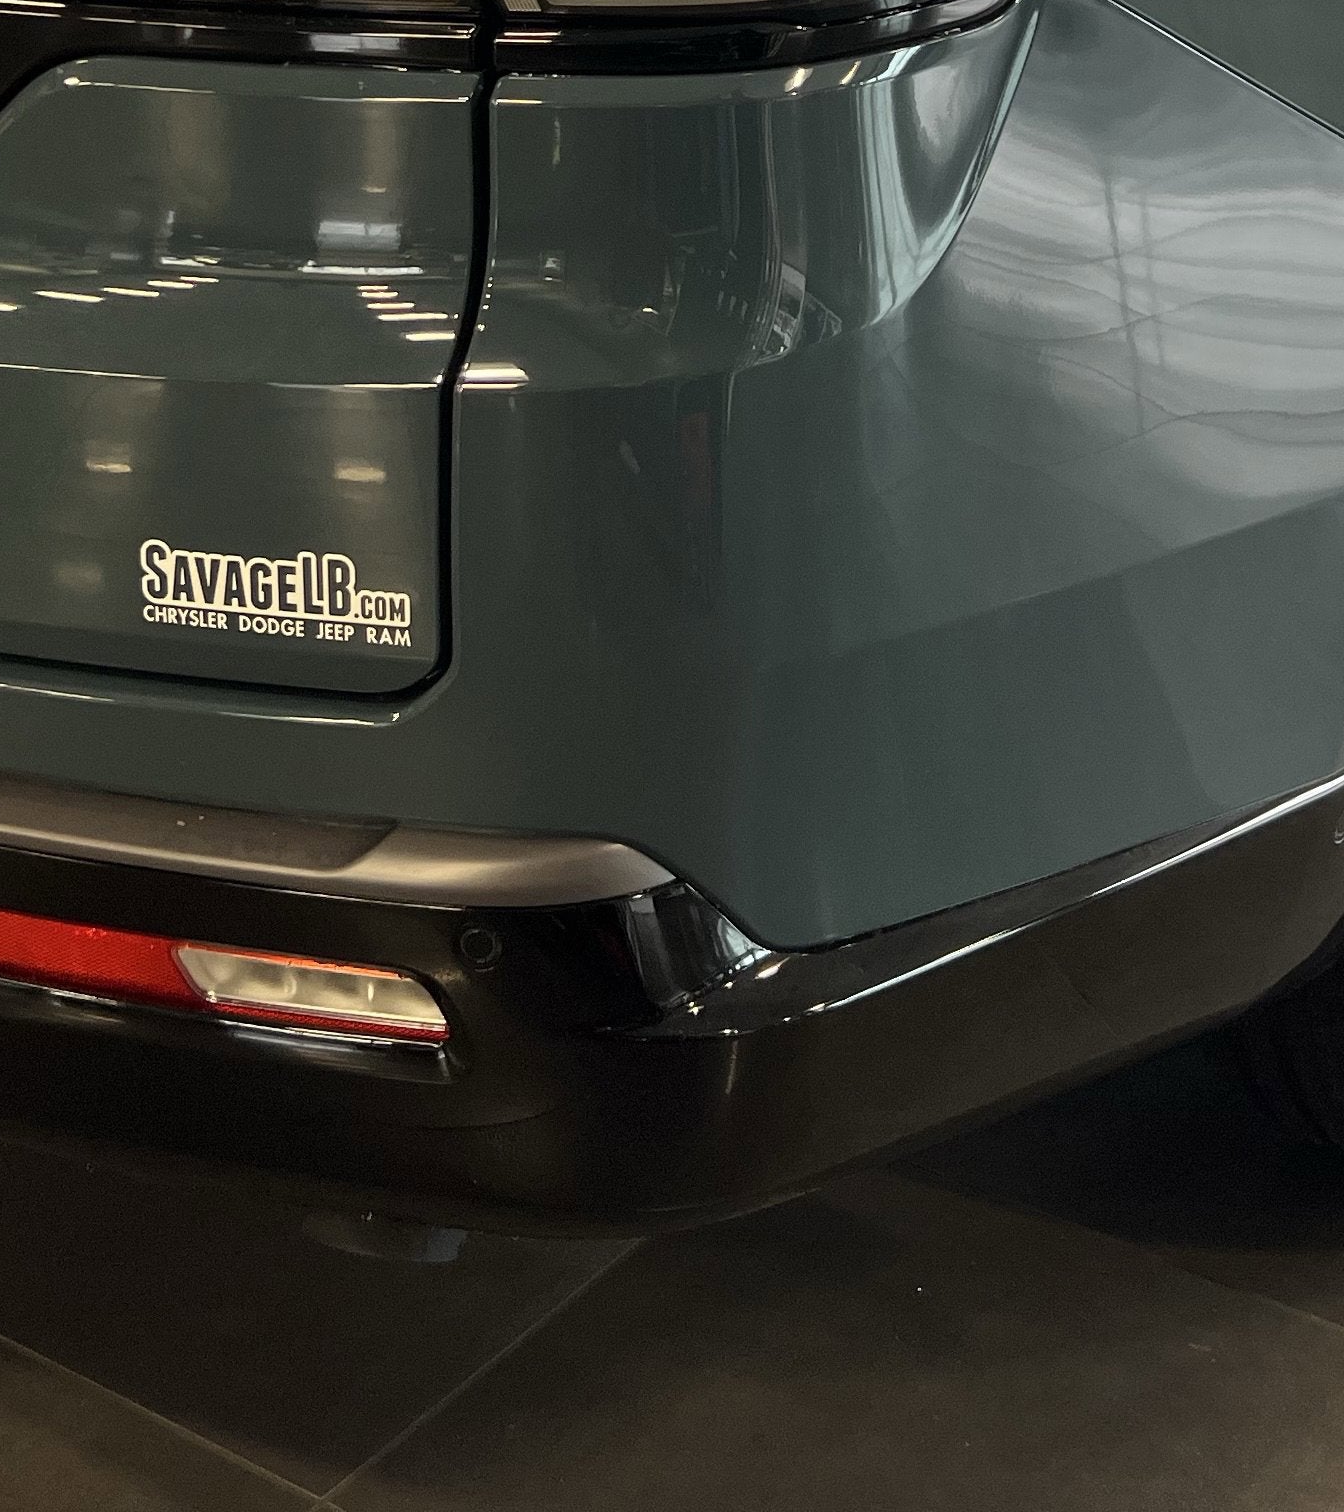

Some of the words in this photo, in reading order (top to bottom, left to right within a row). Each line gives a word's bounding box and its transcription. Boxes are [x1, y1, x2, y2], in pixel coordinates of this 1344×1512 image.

[142, 604, 228, 630] CHRYSLER
[239, 615, 305, 638] DODGE
[316, 622, 355, 641] JEEP
[366, 627, 412, 647] RAM
